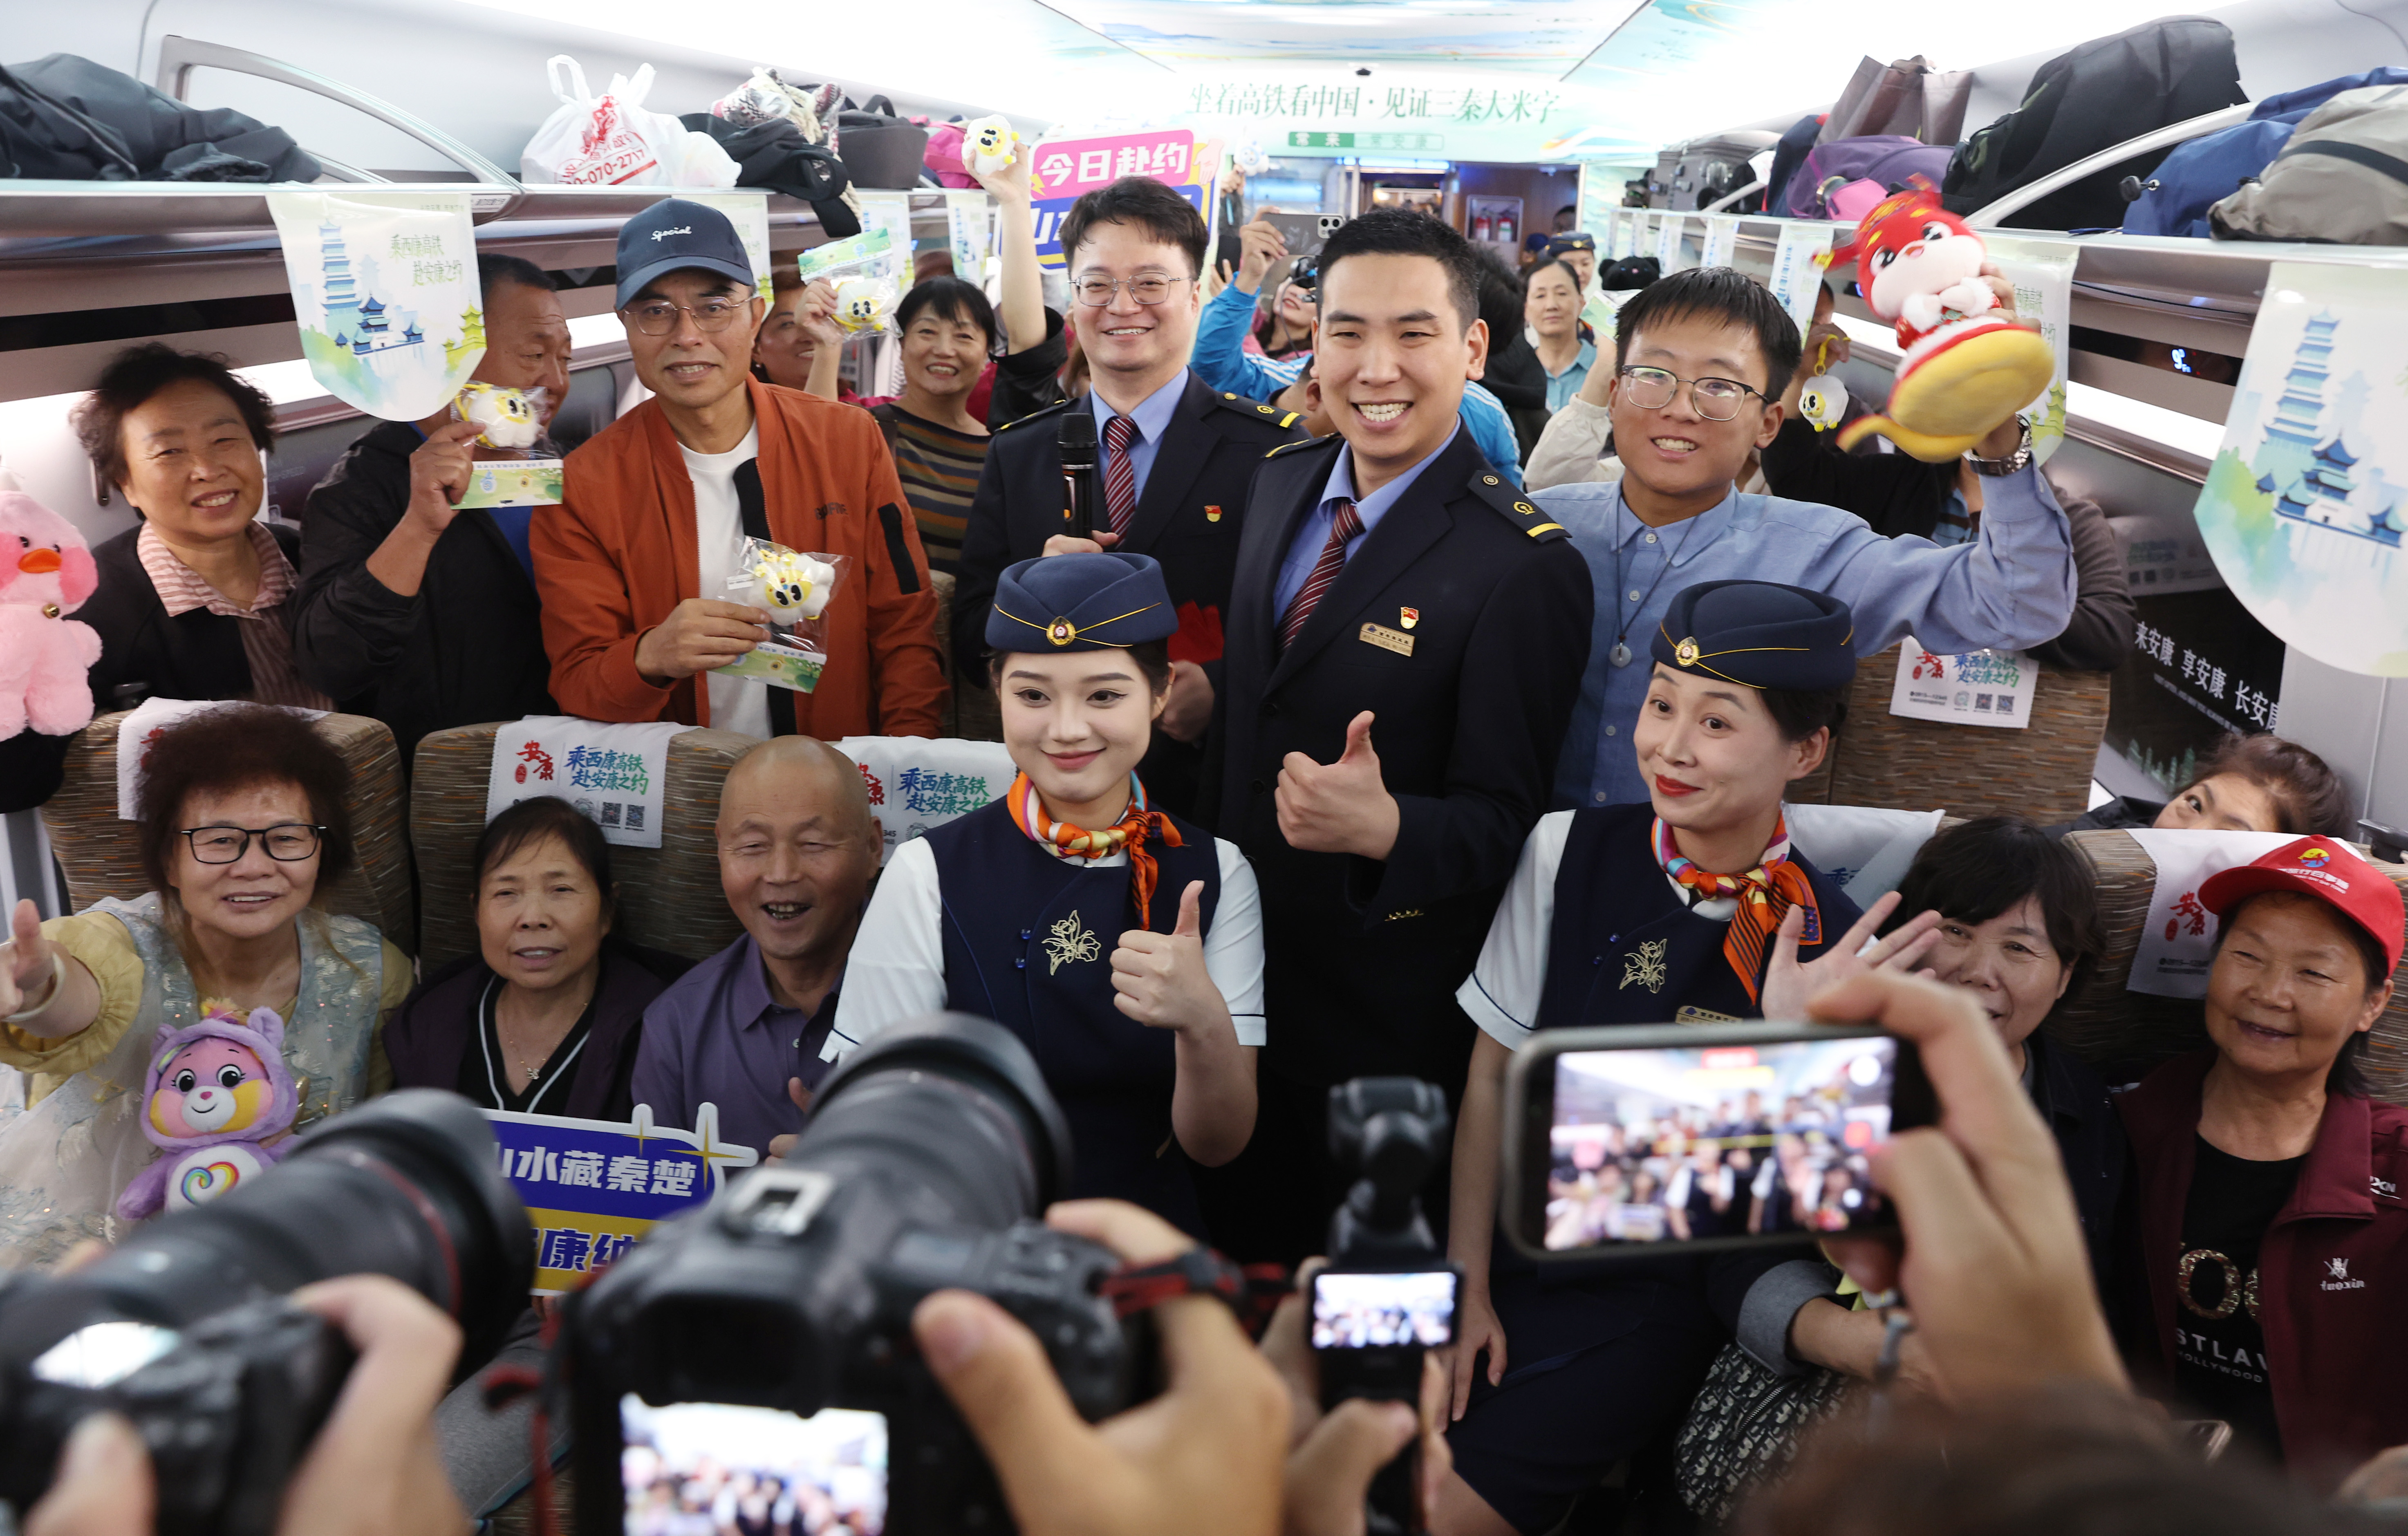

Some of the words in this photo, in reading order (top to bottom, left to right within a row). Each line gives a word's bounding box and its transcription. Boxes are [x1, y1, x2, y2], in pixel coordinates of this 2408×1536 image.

[1039, 141, 1188, 187] 今日赴约
[650, 225, 692, 242] Special
[2134, 620, 2175, 667] 来安康
[2180, 648, 2227, 700] 享安康
[563, 745, 648, 774] 乘西康高铁
[569, 769, 650, 795] 赴安康之约
[896, 767, 992, 797] 乘西康高铁
